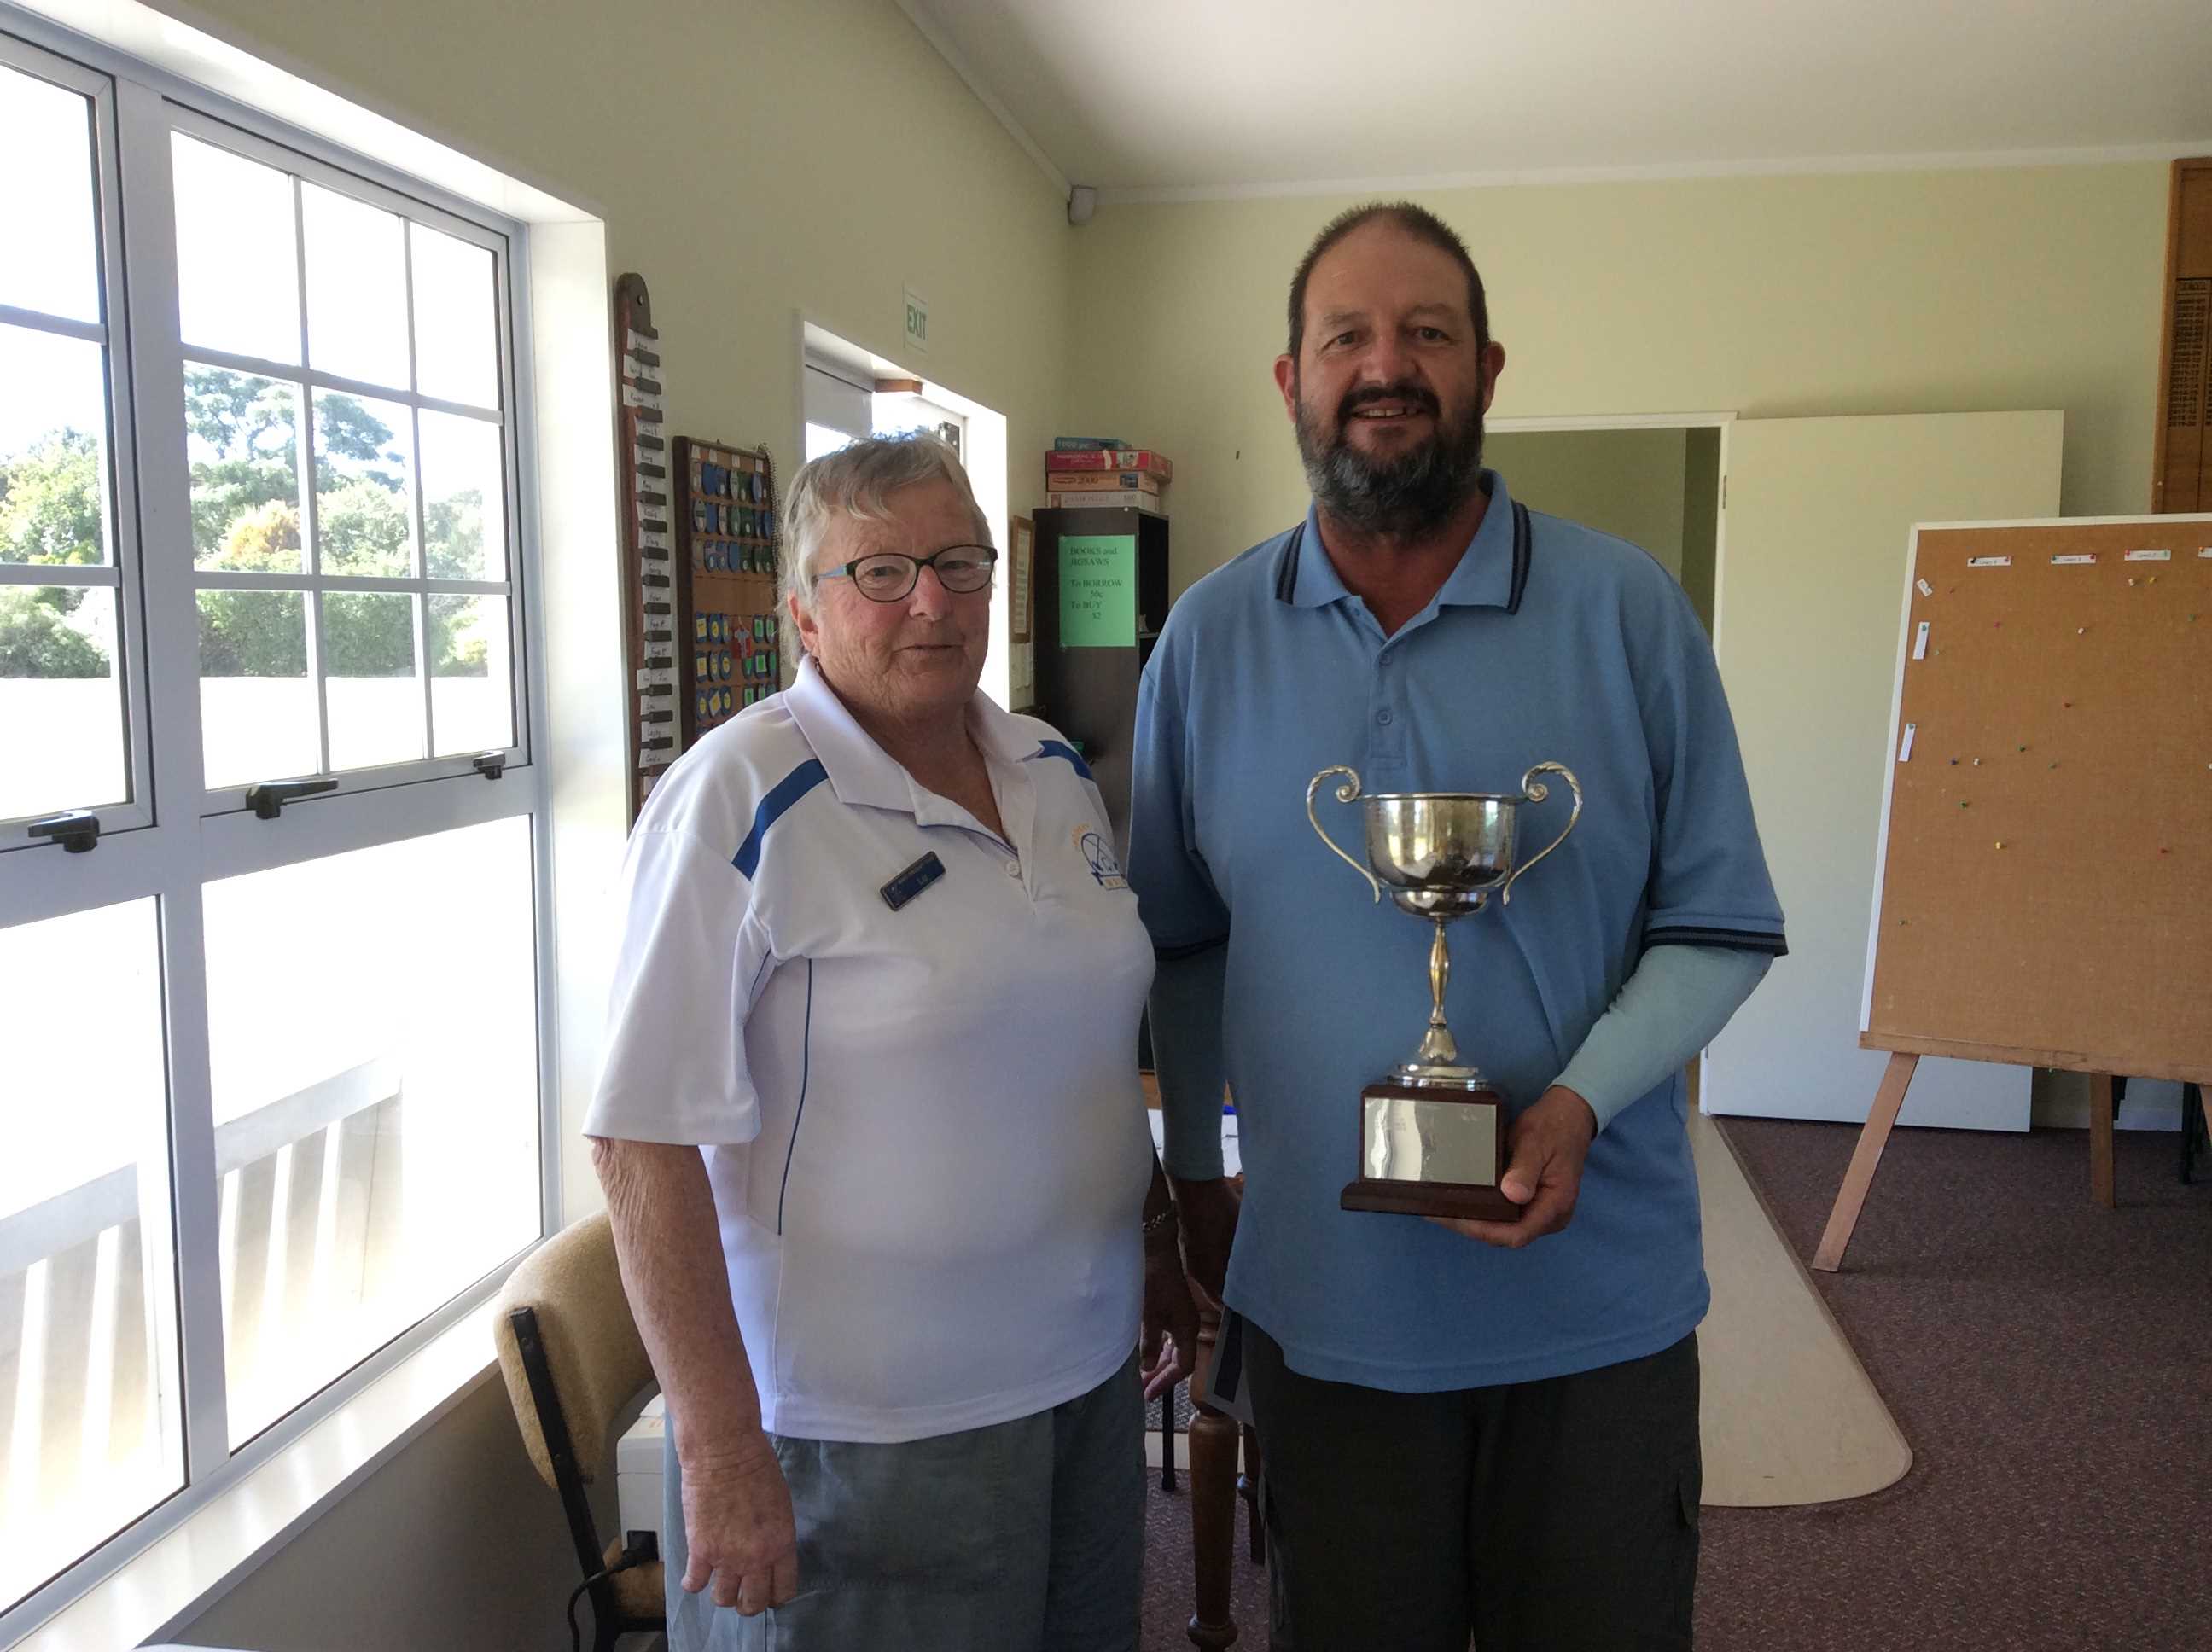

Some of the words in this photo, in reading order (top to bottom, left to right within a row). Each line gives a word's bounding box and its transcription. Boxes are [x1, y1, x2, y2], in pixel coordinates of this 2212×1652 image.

[906, 304, 927, 340] EXIT
[1069, 546, 1101, 556] BOOKS
[1103, 546, 1118, 555] and
[1069, 557, 1109, 567] JIGSAWS
[1070, 579, 1081, 588] To
[1082, 579, 1123, 588] BORROW
[1070, 600, 1081, 609] To
[1082, 600, 1102, 609] BUY
